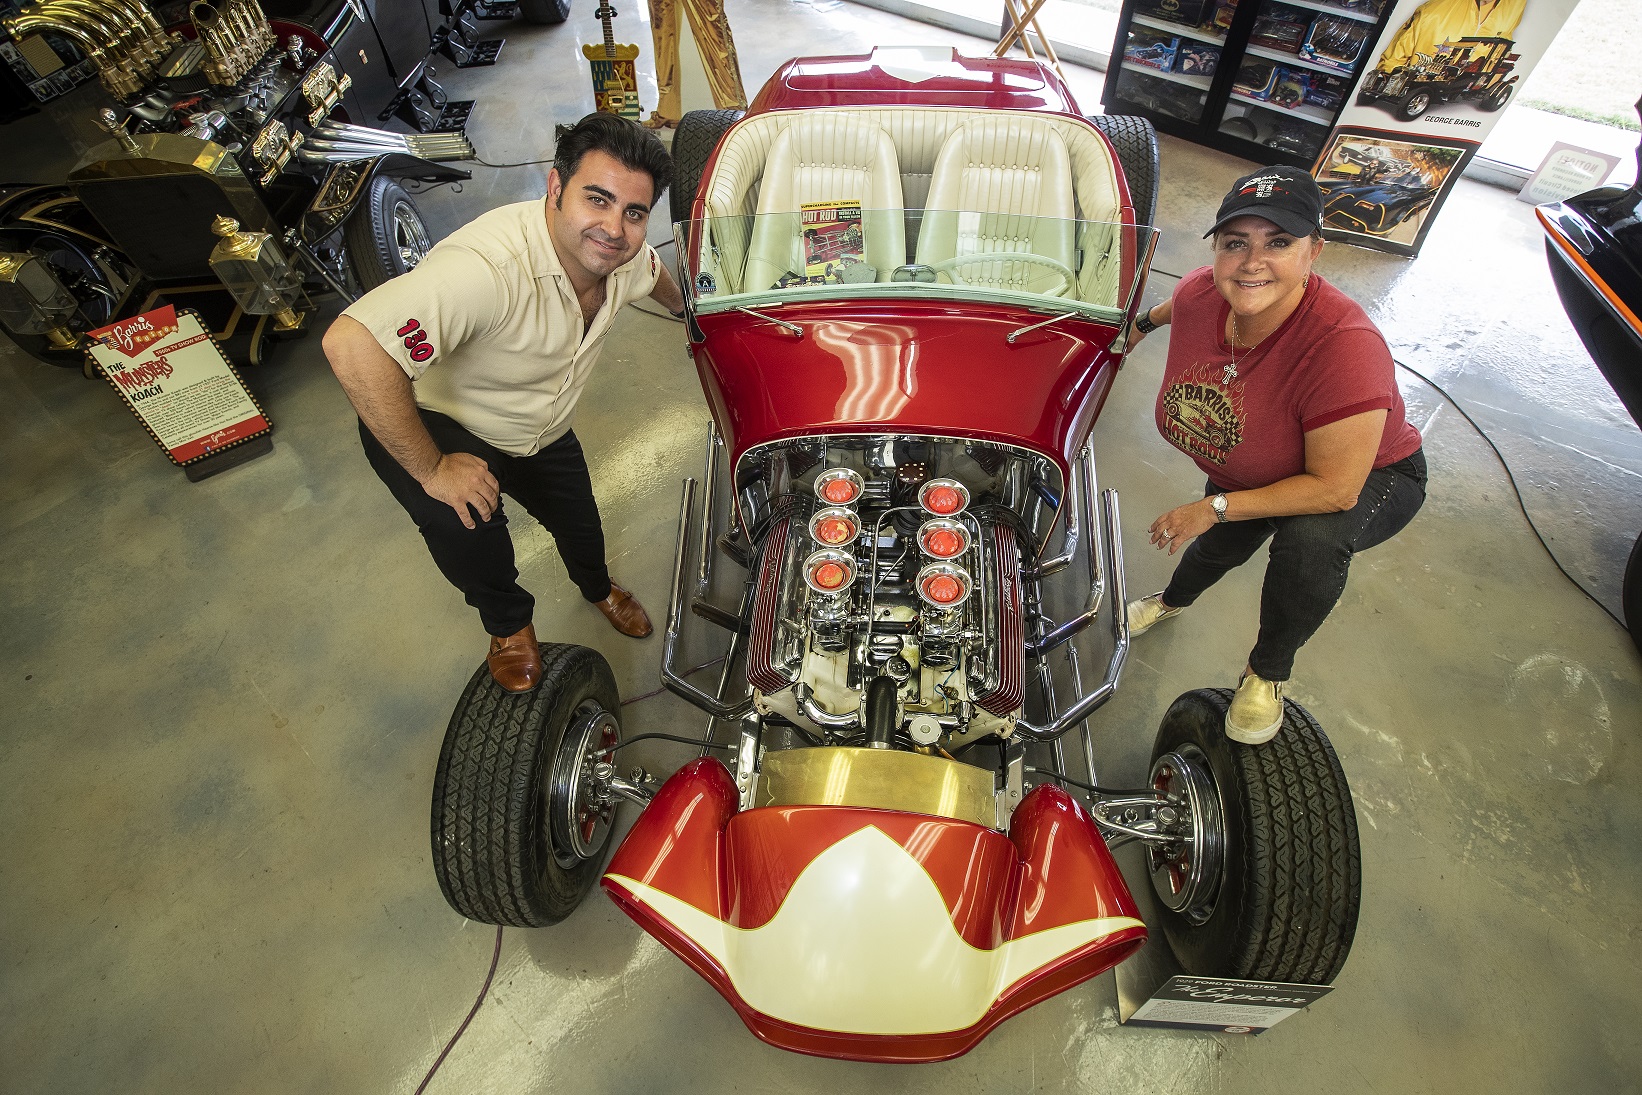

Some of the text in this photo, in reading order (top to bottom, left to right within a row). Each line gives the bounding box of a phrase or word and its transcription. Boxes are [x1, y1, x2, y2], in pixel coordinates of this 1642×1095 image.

[1424, 115, 1482, 128] GEORGE BARRIS
[802, 209, 837, 222] HOT ROD
[113, 316, 155, 351] Barris
[177, 340, 193, 348] SHOW
[192, 334, 206, 343] ROD
[396, 318, 435, 362] 130
[107, 361, 126, 374] THE
[111, 356, 174, 395] MUNSTERS
[129, 384, 163, 403] KOACH
[1184, 384, 1231, 421] BARRIS
[1224, 982, 1278, 990] ROADSTER
[1188, 987, 1308, 1003] Emperor
